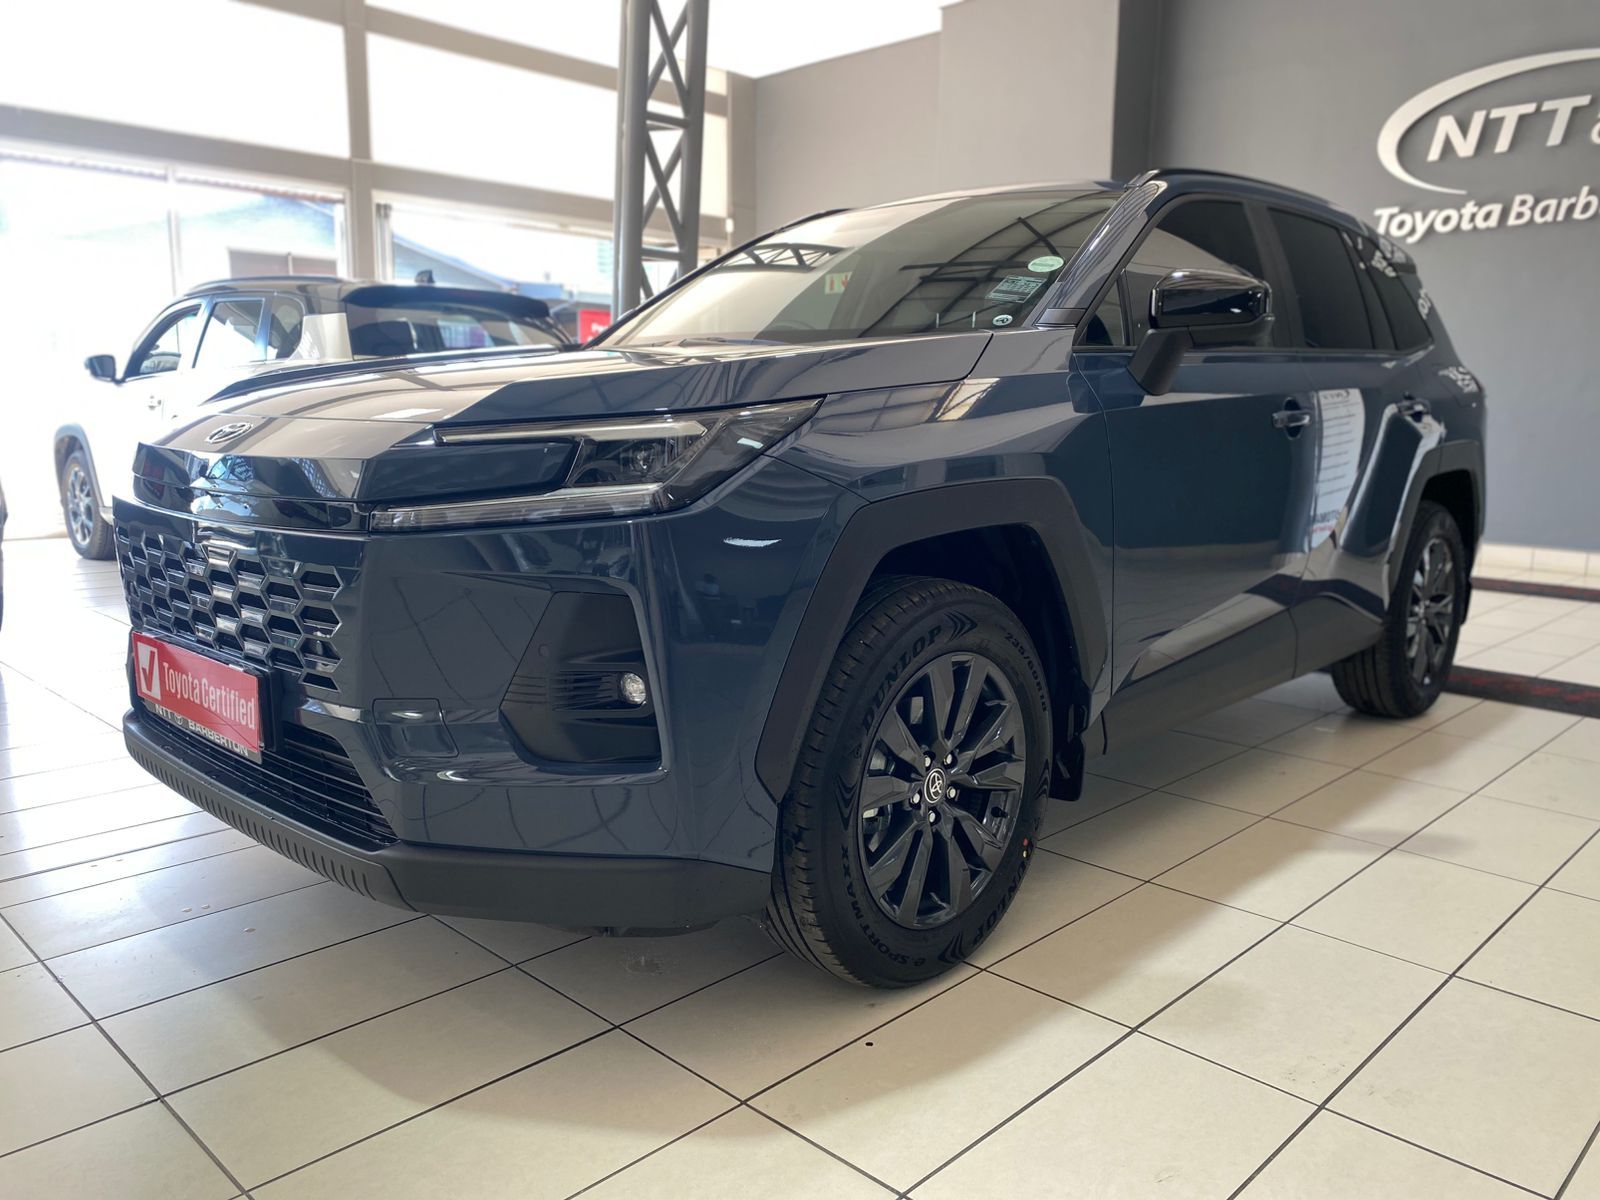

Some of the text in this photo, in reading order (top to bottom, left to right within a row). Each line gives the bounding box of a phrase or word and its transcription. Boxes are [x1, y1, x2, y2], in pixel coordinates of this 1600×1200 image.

[1427, 94, 1592, 162] NTT
[1373, 185, 1600, 244] Toyota Barb
[863, 624, 942, 736] DUNLOP
[188, 719, 249, 757] BARBERTON
